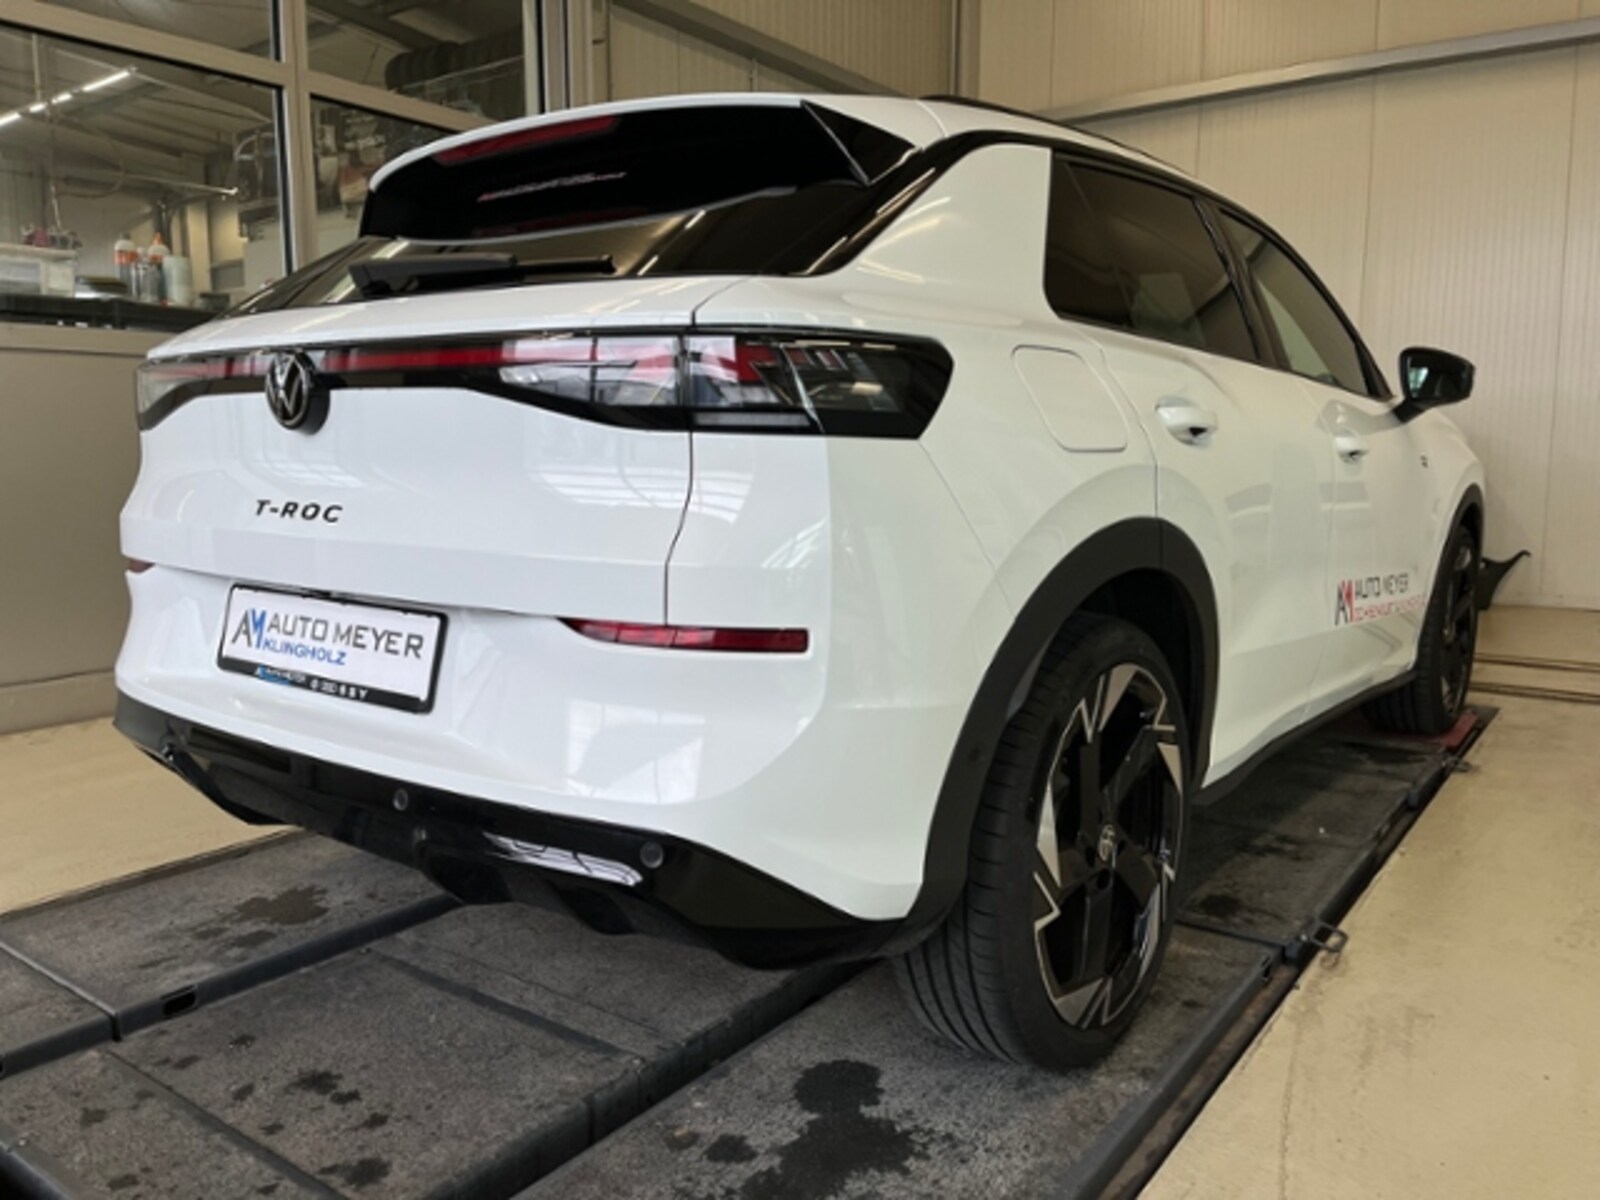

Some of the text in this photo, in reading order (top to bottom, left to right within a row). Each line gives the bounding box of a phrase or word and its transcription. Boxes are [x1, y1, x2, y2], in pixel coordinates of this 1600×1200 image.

[255, 499, 343, 523] T-ROC
[266, 613, 424, 659] AUTO MEYER
[263, 637, 347, 666] KLINGHOLZ
